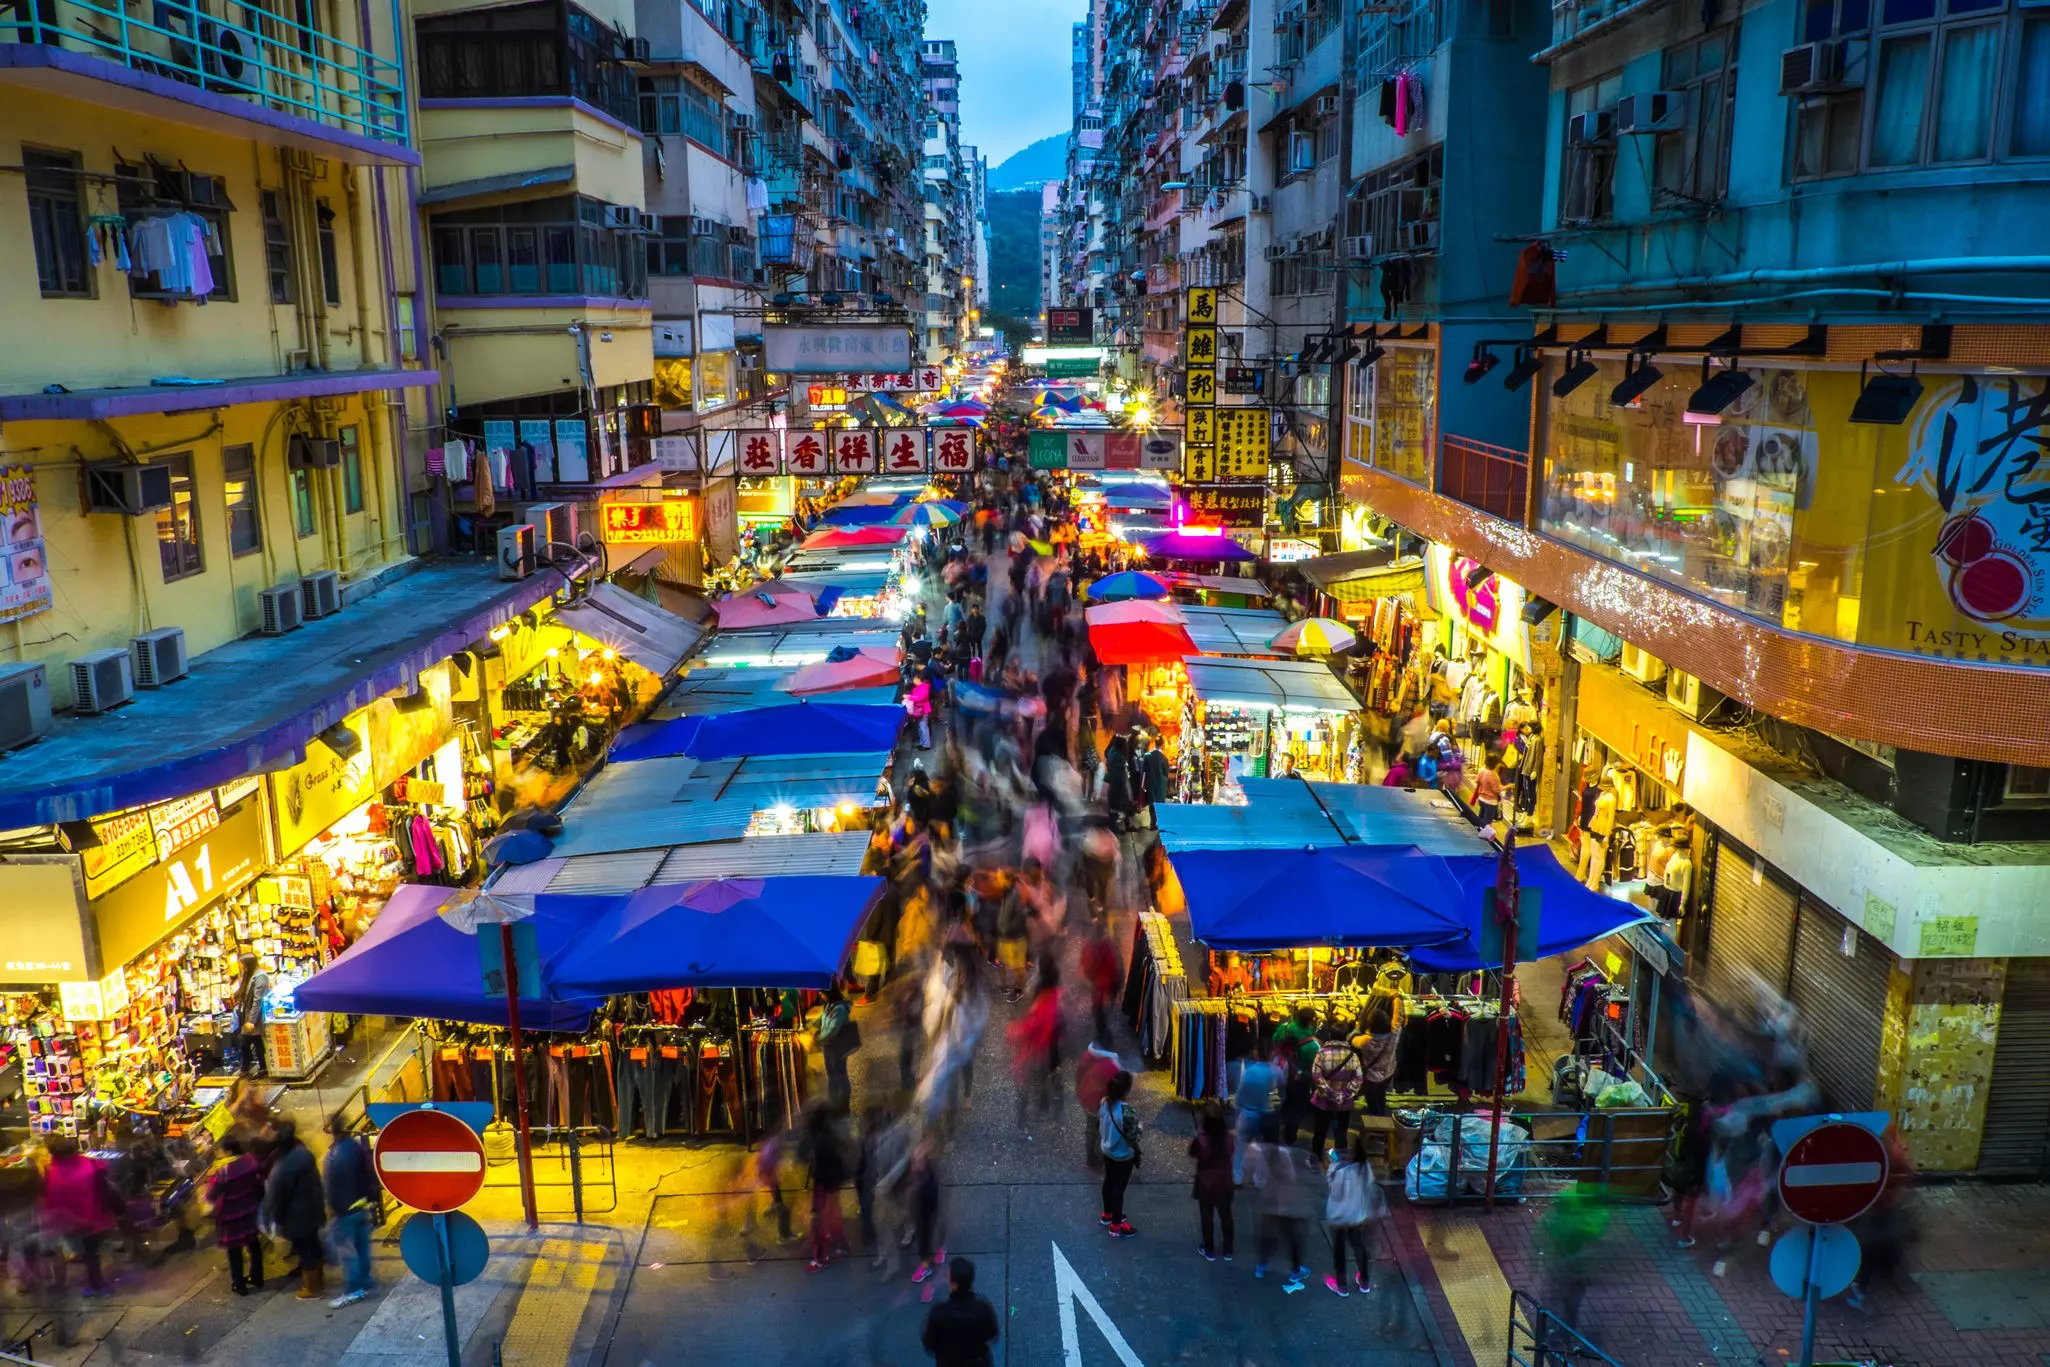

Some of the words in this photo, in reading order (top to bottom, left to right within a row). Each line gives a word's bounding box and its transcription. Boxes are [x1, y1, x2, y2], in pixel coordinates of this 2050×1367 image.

[1993, 538, 2038, 568] GOLDEN
[2034, 568, 2045, 592] SUN
[2019, 594, 2044, 620] STAR
[1907, 621, 1988, 649] TASTY
